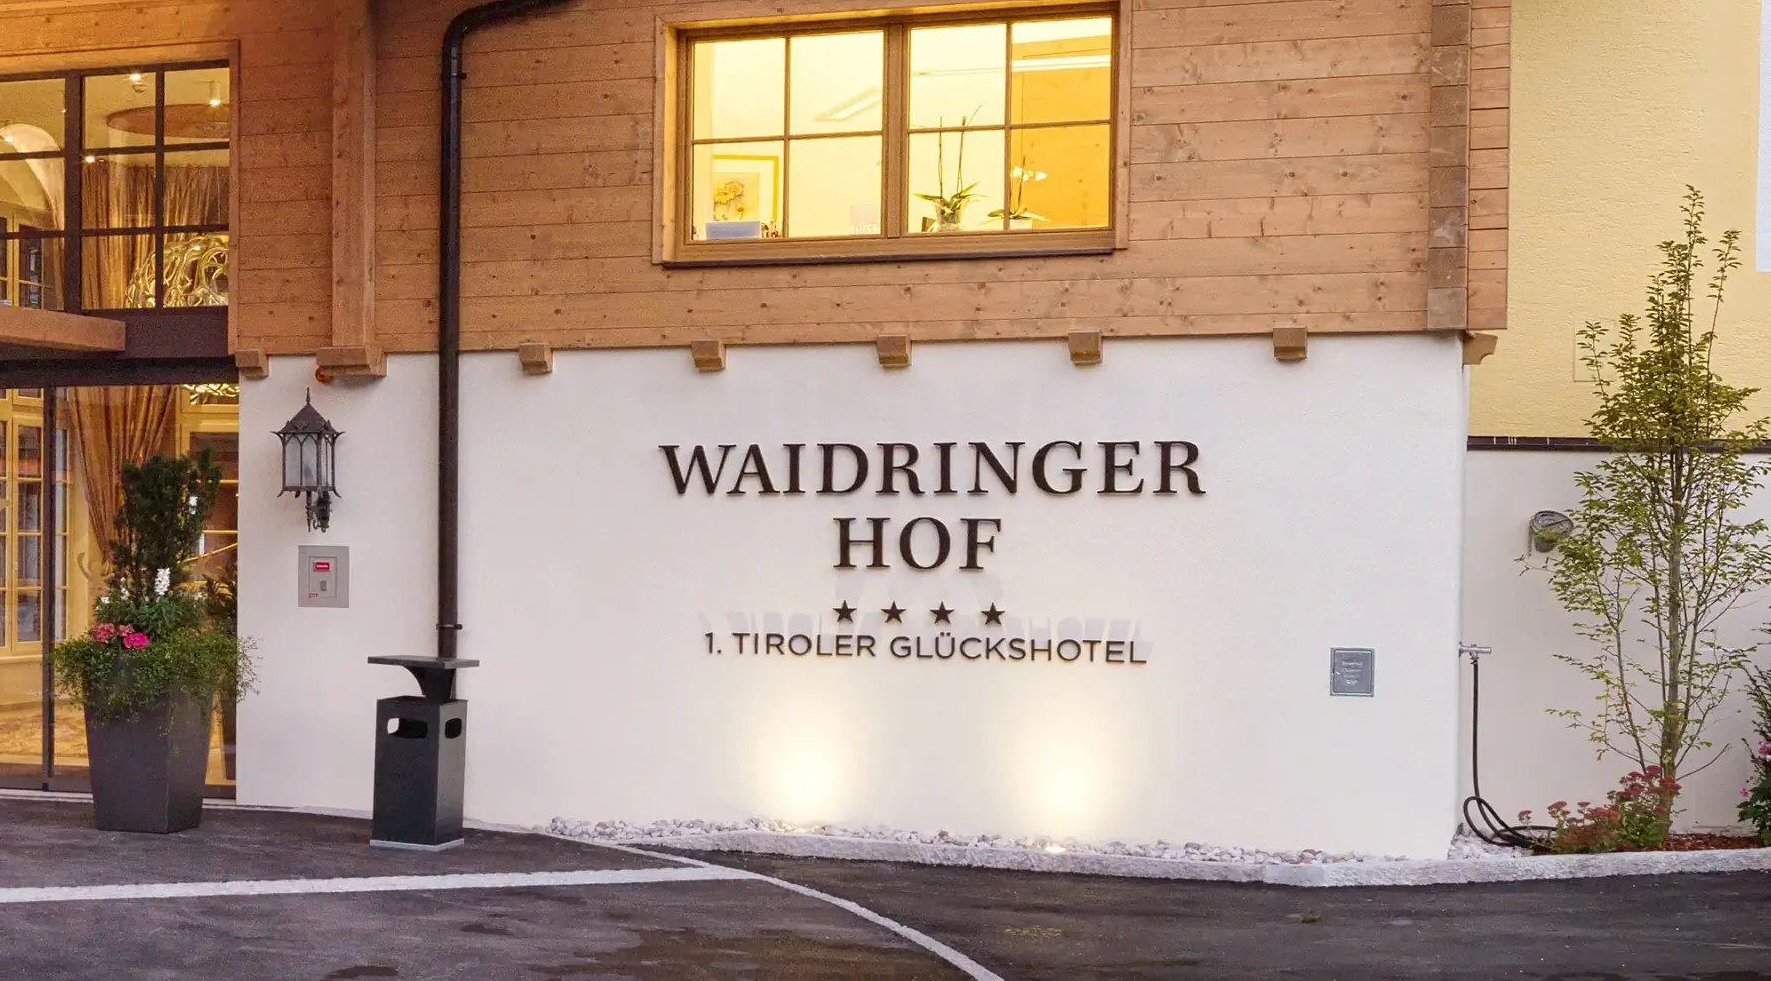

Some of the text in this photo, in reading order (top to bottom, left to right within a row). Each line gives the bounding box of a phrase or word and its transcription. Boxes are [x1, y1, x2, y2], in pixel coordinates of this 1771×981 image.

[658, 440, 1207, 497] WAIDRINGER
[832, 516, 1002, 573] HOF
[704, 631, 1148, 665] 1. TIROLER GLÜCKSHOTEL
